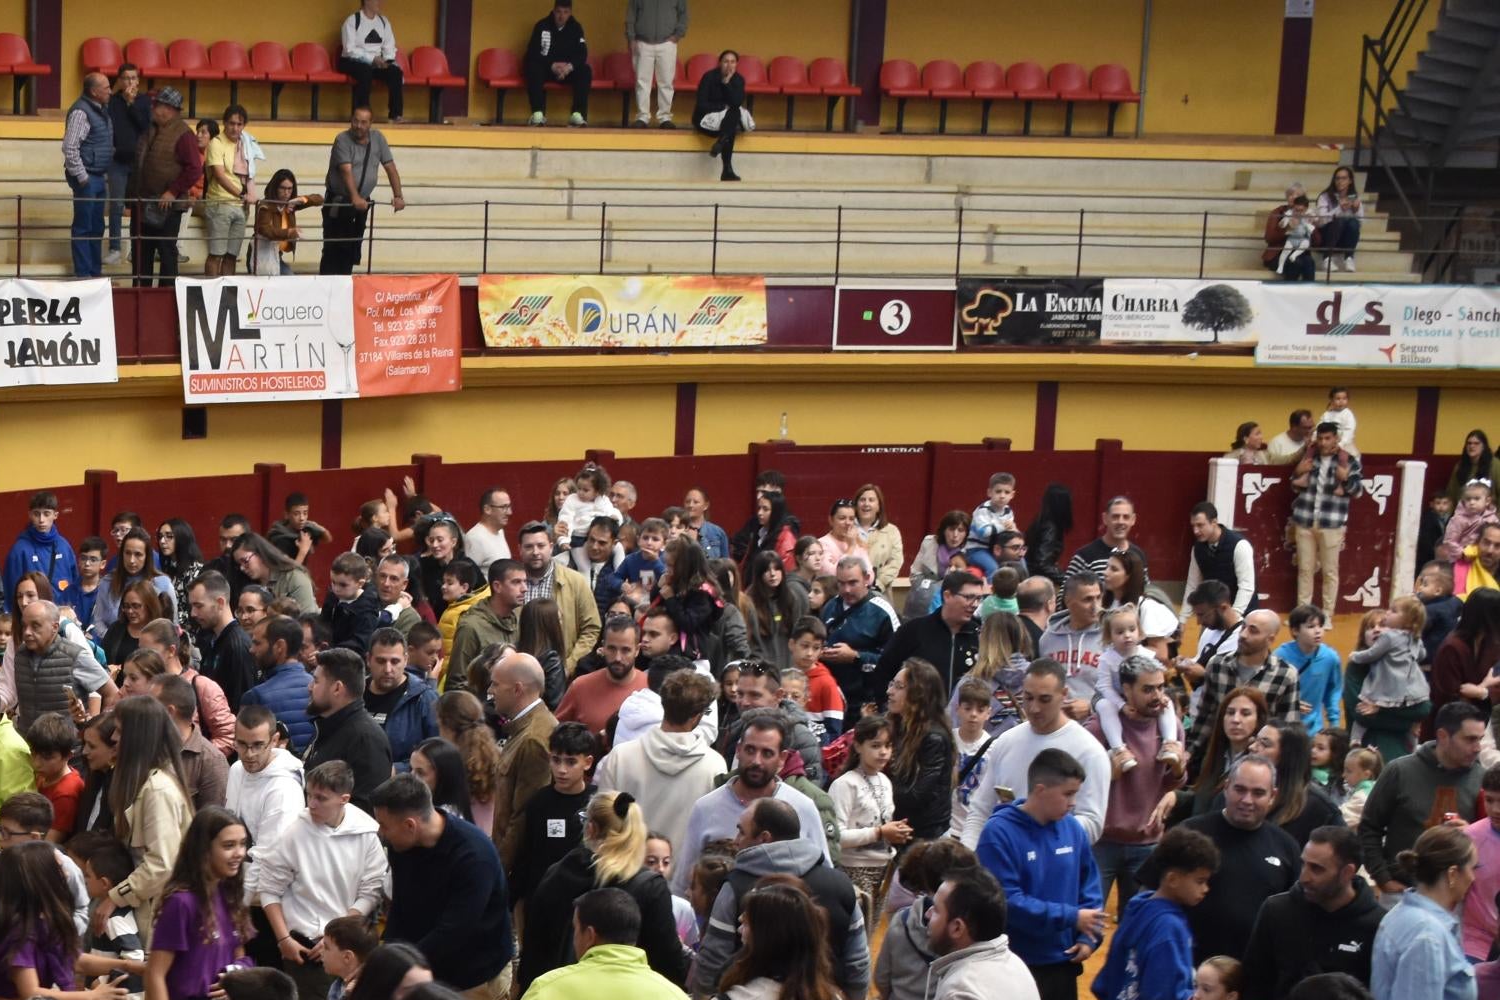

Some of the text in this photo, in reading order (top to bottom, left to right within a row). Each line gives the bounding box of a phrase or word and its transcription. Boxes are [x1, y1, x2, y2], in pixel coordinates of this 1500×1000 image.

[1015, 293, 1179, 313] LA ENCINA CHARRA
[400, 306, 414, 316] Los
[888, 303, 903, 332] 3
[1404, 306, 1441, 325] Diego
[388, 321, 403, 331] 923
[390, 336, 406, 346] 923
[4, 331, 101, 367] JAMÓN
[359, 352, 383, 363] 37184
[385, 349, 412, 361] Villares
[431, 347, 454, 357] Reina
[1400, 343, 1439, 356] Seguros
[1400, 354, 1432, 364] Bilbao
[386, 364, 430, 378] (Salamanca)
[191, 375, 325, 391] SUMINISTROS HOSTELEROS
